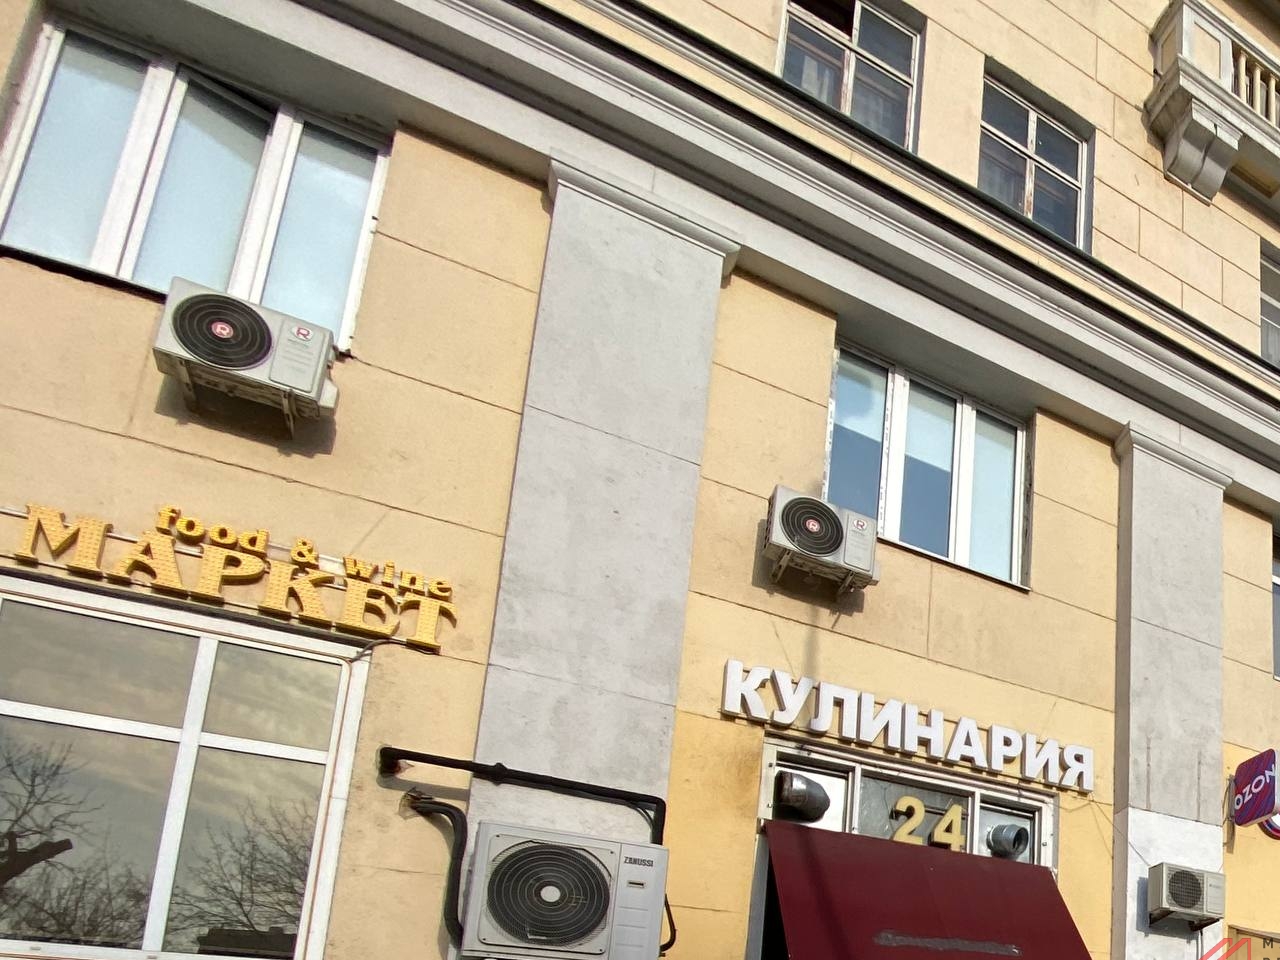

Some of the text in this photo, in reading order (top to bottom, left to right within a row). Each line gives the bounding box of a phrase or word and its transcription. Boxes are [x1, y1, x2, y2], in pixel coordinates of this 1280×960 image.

[12, 503, 458, 655] МАРКЕТ
[156, 504, 453, 600] food & wine
[721, 658, 1095, 793] КУЛИНАРИЯ
[890, 796, 967, 853] 24
[1234, 763, 1276, 810] OZON
